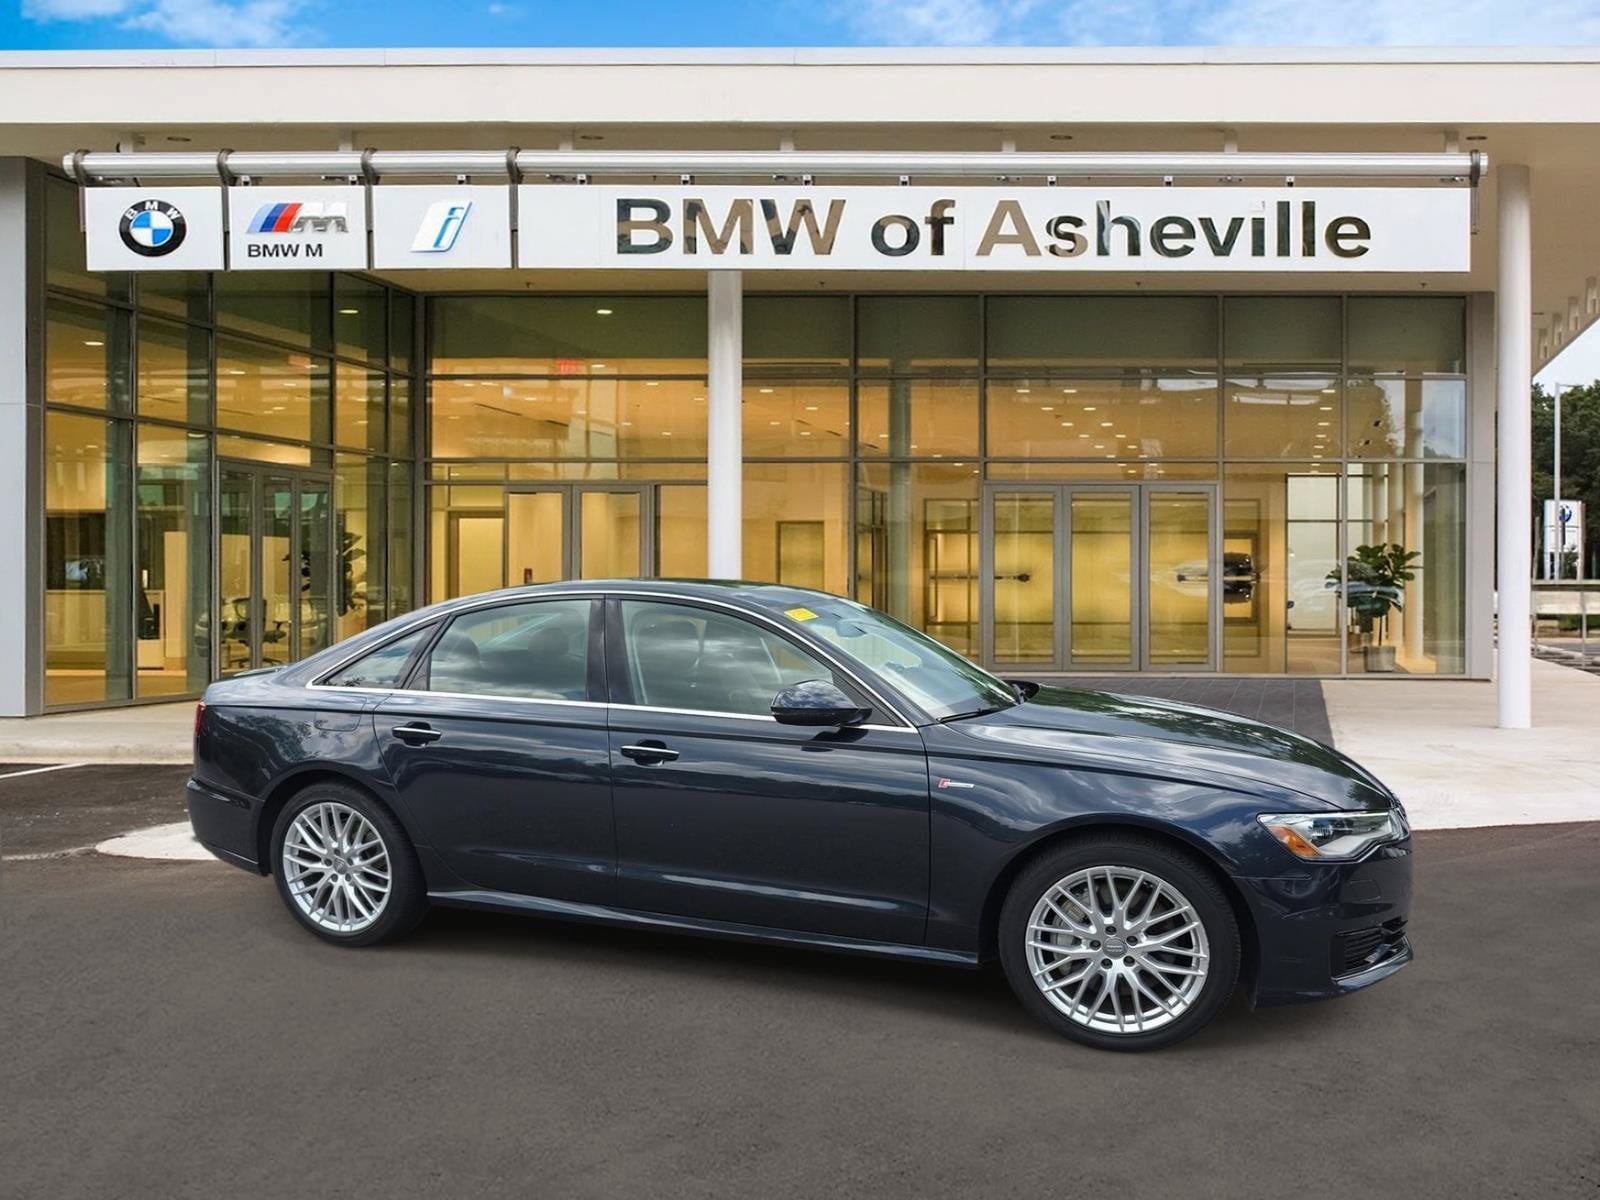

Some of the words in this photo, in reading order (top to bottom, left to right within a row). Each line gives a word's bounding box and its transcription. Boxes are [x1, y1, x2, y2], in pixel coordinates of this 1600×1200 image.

[125, 200, 182, 220] BMW
[616, 198, 847, 256] BMW
[870, 198, 956, 257] of
[974, 199, 1372, 258] Asheville
[247, 243, 300, 258] BMW
[305, 243, 324, 258] M
